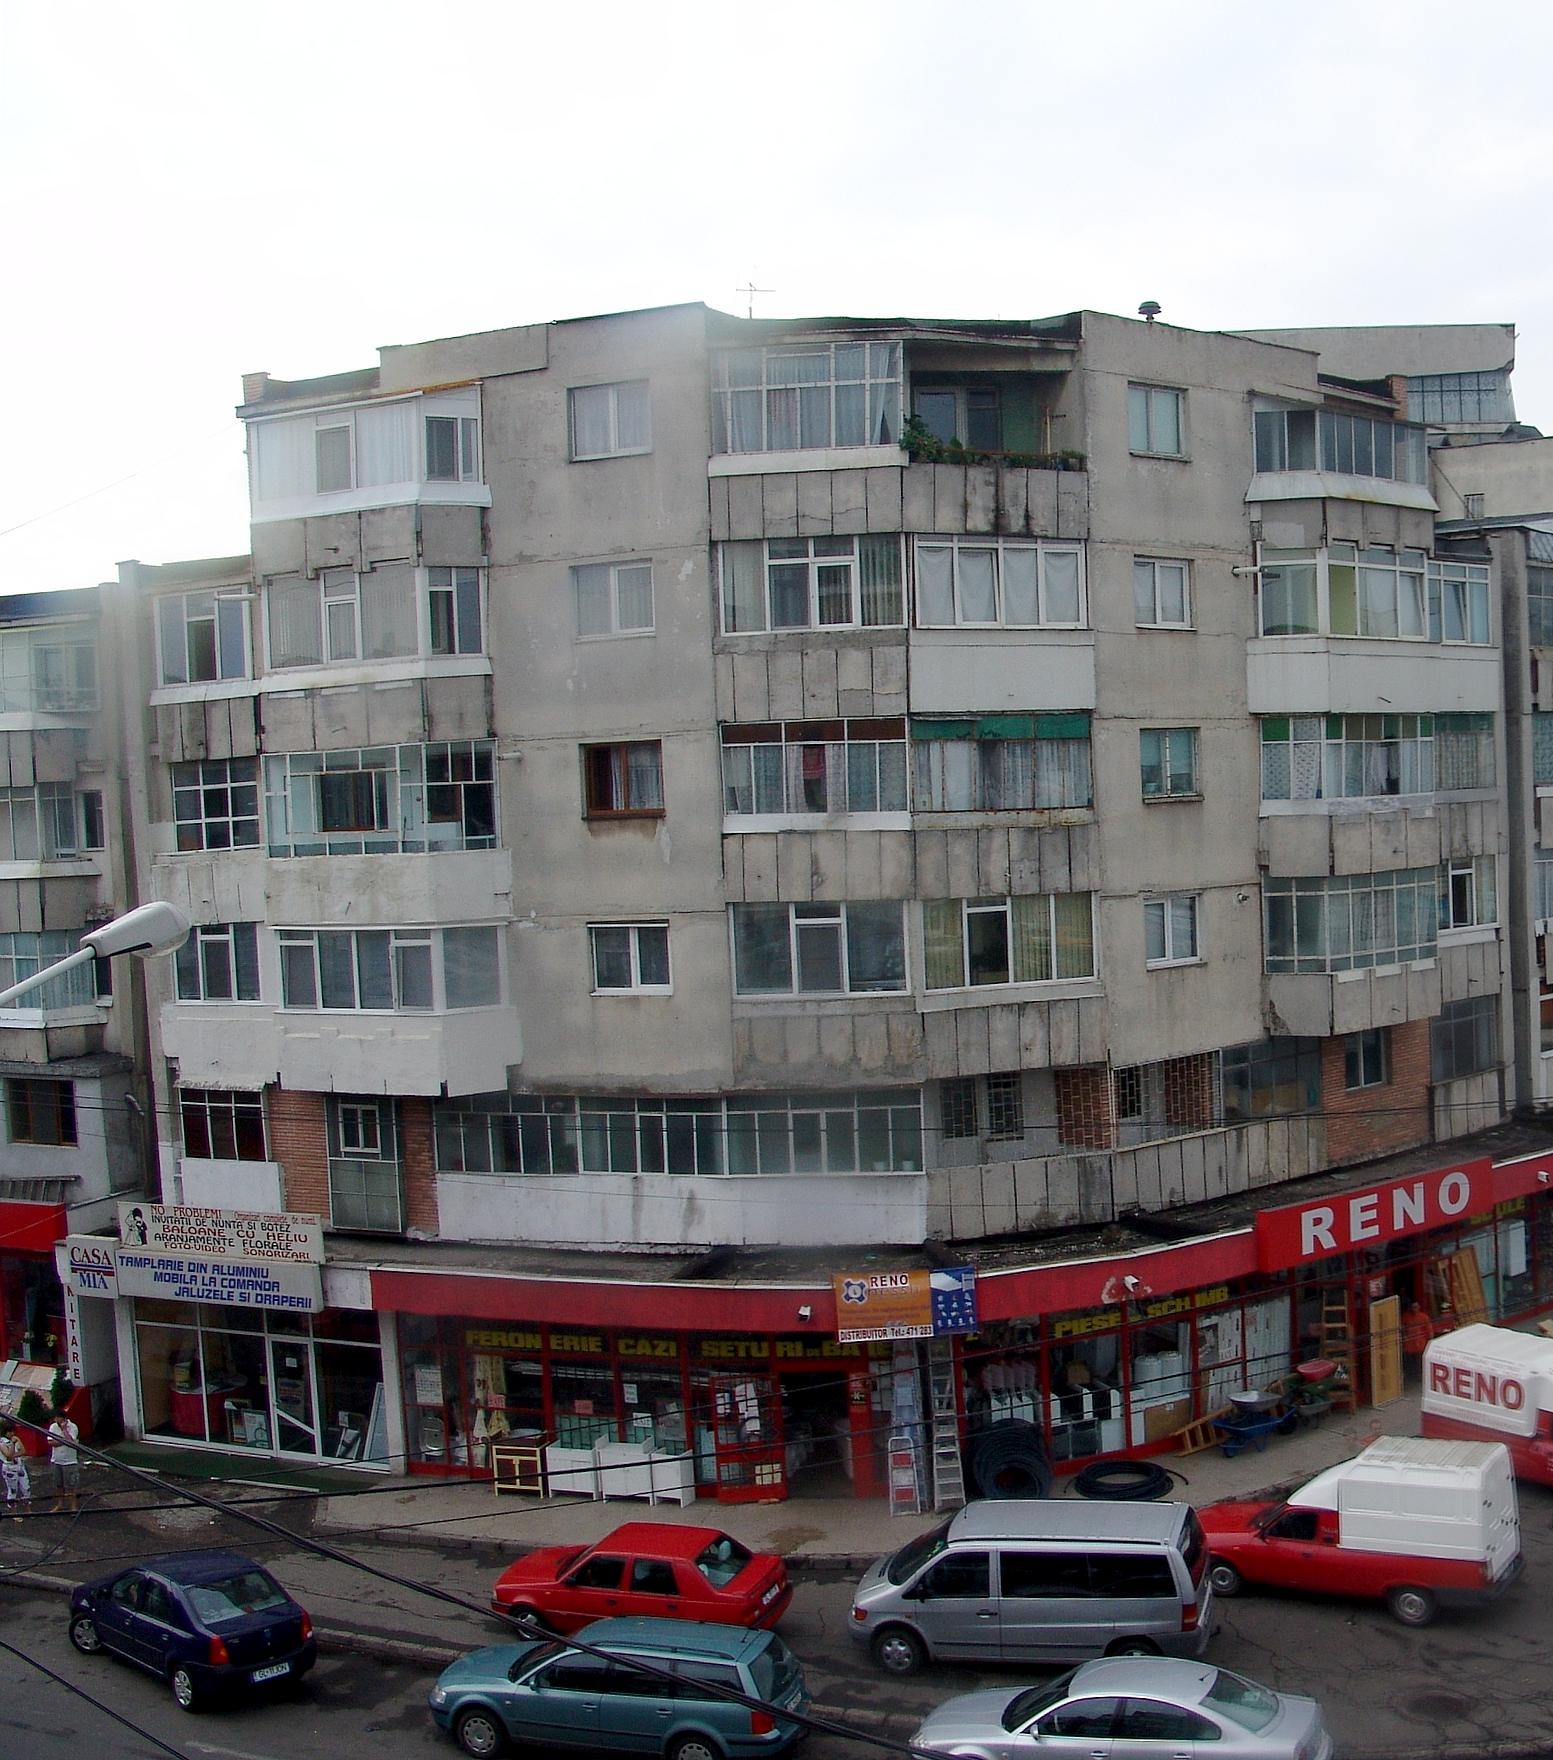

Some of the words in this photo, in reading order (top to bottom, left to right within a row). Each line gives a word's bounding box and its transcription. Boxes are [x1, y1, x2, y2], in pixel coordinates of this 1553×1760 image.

[151, 1205, 165, 1216] NO
[174, 1206, 222, 1220] PROBLEM!
[1301, 1172, 1471, 1256] RENO
[152, 1215, 191, 1226] INVITATII
[195, 1218, 208, 1227] DE
[212, 1219, 243, 1230] NUNTA
[248, 1222, 256, 1231] SI
[261, 1223, 291, 1233] BOTEZ
[154, 1232, 235, 1248] ARANJAMENTE
[242, 1240, 293, 1251] FLORALE
[162, 1225, 226, 1238] BALOANE
[236, 1230, 255, 1239] CU
[266, 1232, 308, 1243] HELIU
[70, 1246, 112, 1265] CASA
[164, 1242, 226, 1253] FOTO-VIDEO
[243, 1248, 310, 1260] SONORIZARI
[118, 1255, 184, 1272] TAMPLARIE
[187, 1261, 207, 1274] DIN
[211, 1264, 269, 1279] ALUMINIU
[79, 1271, 109, 1290] MIA
[153, 1271, 198, 1286] MOBILA
[201, 1275, 217, 1288] LA
[220, 1277, 280, 1292] COMANDA
[870, 1274, 909, 1287] RENO
[174, 1286, 235, 1302] JALUZELE
[238, 1292, 250, 1303] SI
[255, 1292, 312, 1309] DRAPERII
[840, 1328, 887, 1341] DISTRIBUITOR
[1429, 1362, 1526, 1411] RENO
